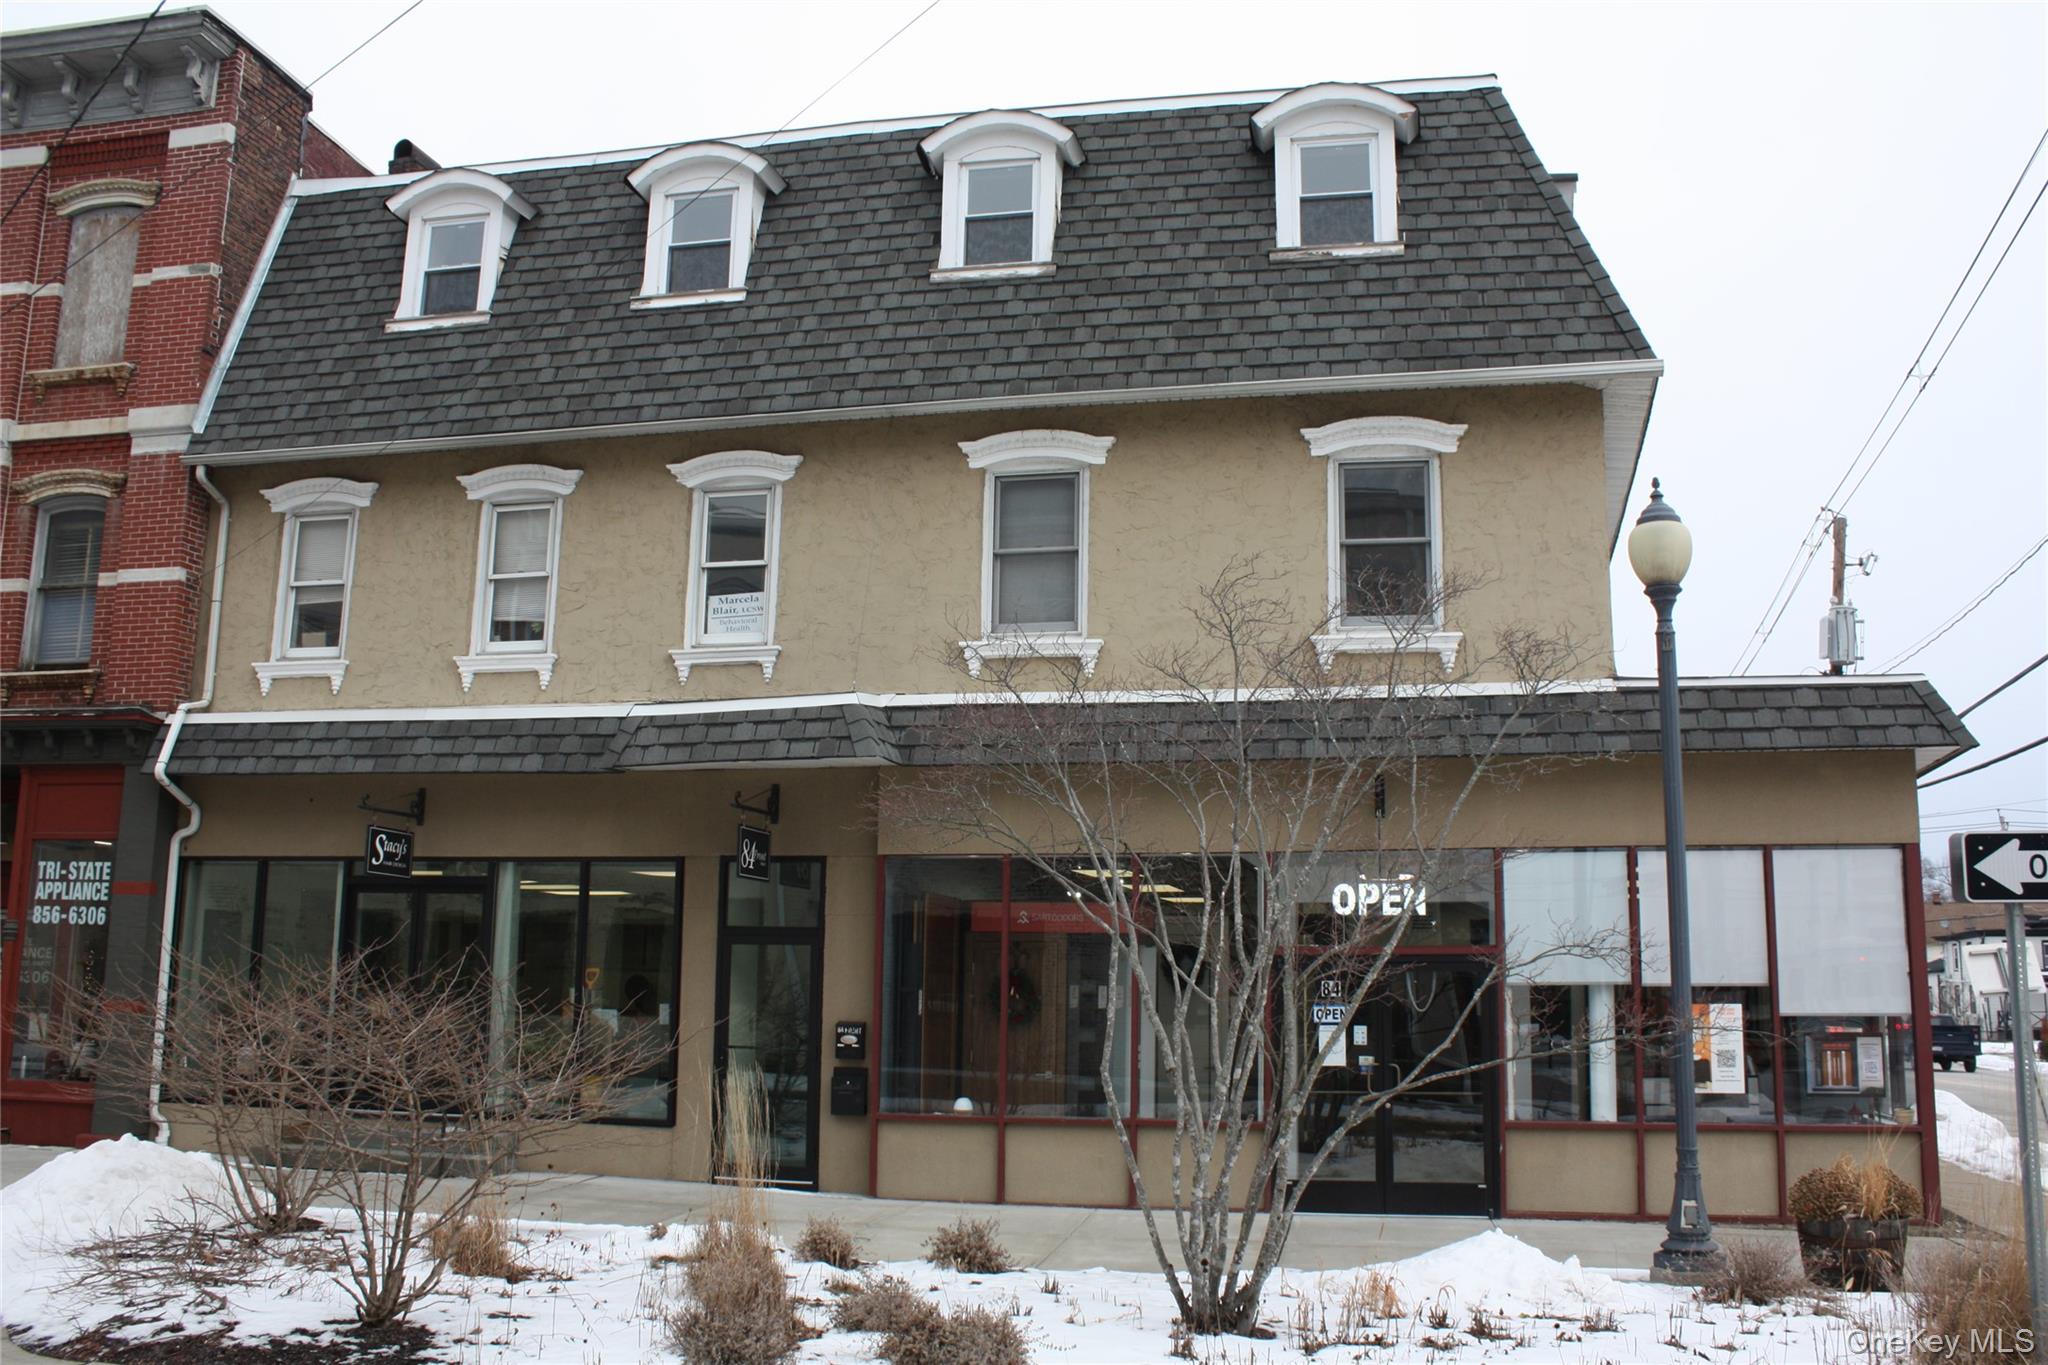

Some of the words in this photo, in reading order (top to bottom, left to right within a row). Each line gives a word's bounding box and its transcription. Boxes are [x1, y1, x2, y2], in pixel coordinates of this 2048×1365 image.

[718, 595, 760, 605] Marcela
[713, 606, 739, 616] Blair,
[720, 617, 758, 626] Behavioral
[726, 625, 752, 633] Health
[371, 833, 408, 865] Stacy's
[741, 838, 757, 870] 84
[38, 861, 112, 880] TRI-STATE
[34, 882, 109, 901] APPLIANCE
[1332, 883, 1427, 916] OPEN
[32, 905, 107, 925] 856-6306
[1322, 981, 1340, 997] 84
